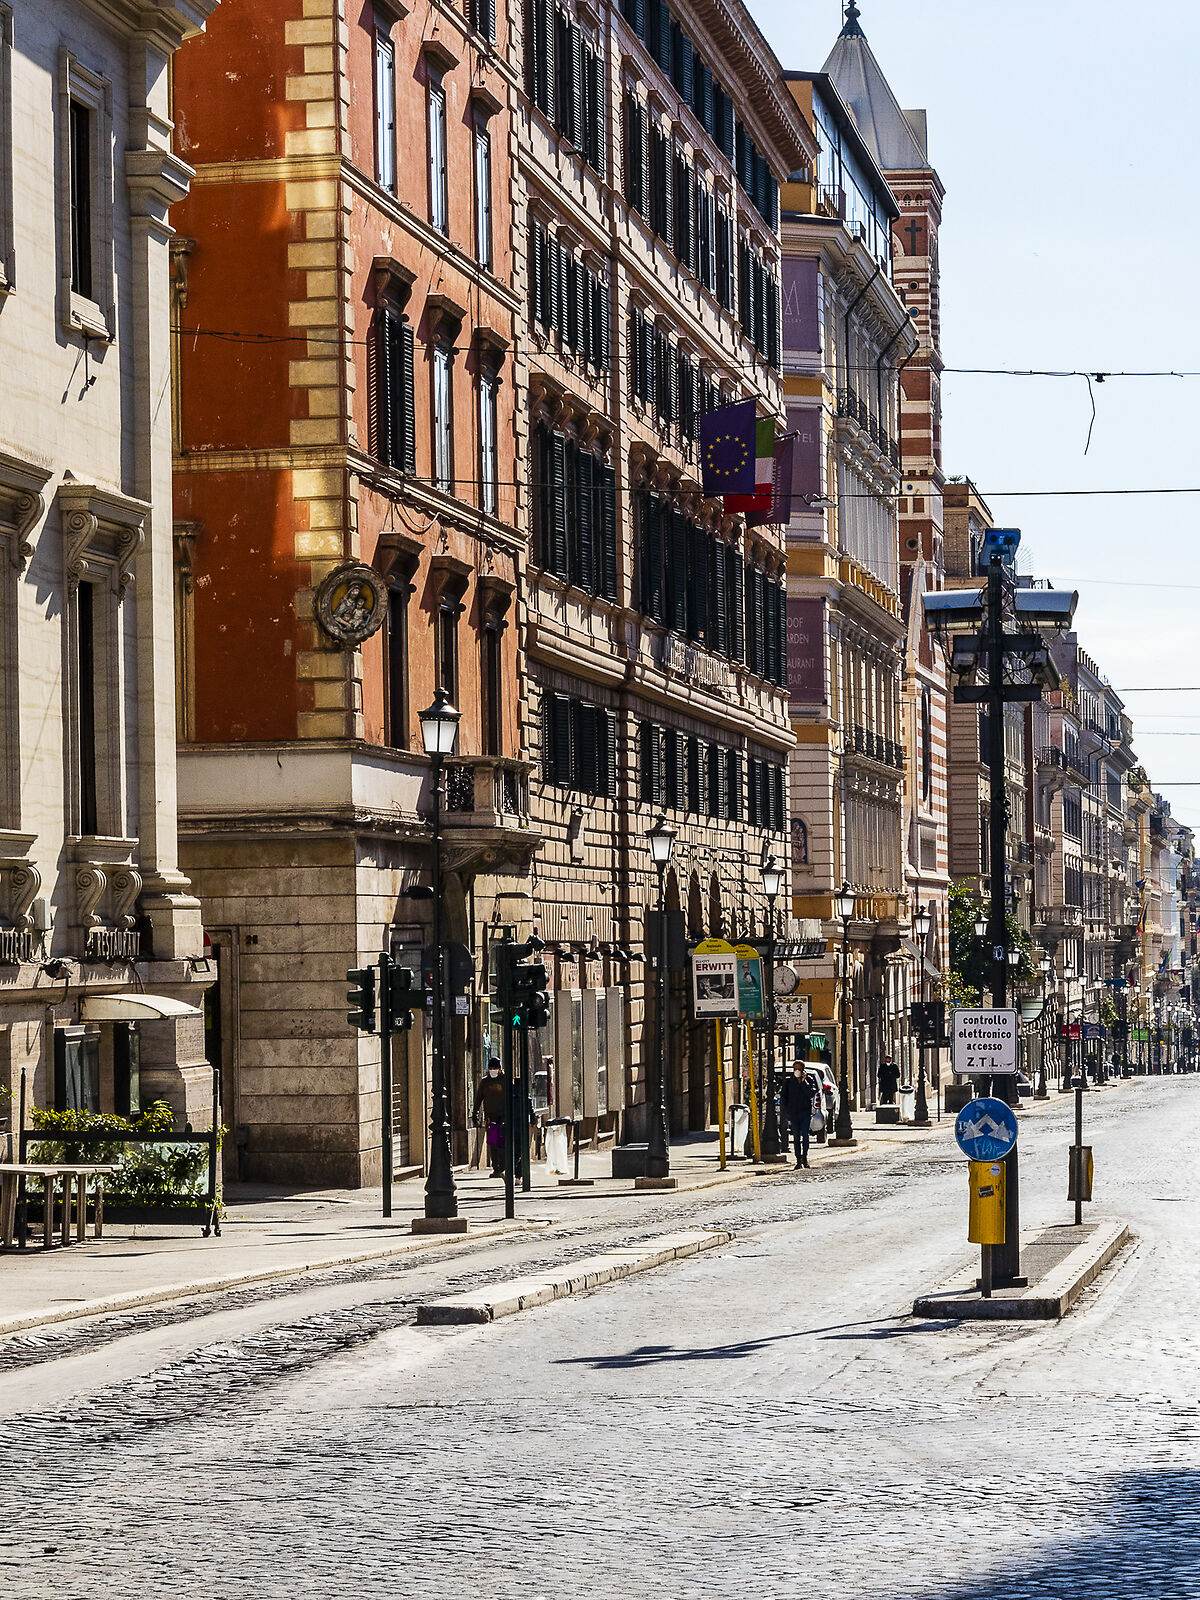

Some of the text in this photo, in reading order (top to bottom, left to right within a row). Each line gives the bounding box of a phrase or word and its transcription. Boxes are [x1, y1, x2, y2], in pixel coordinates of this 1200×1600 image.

[796, 432, 815, 444] TEL
[787, 617, 804, 629] OOF
[787, 633, 809, 644] ARDEN
[787, 658, 815, 669] AURANT
[695, 962, 734, 971] ERWITT
[963, 1015, 1007, 1025] controllo
[958, 1028, 1012, 1039] elettronico
[966, 1043, 1003, 1051] accesso
[967, 1057, 1002, 1068] Z.T.L.
